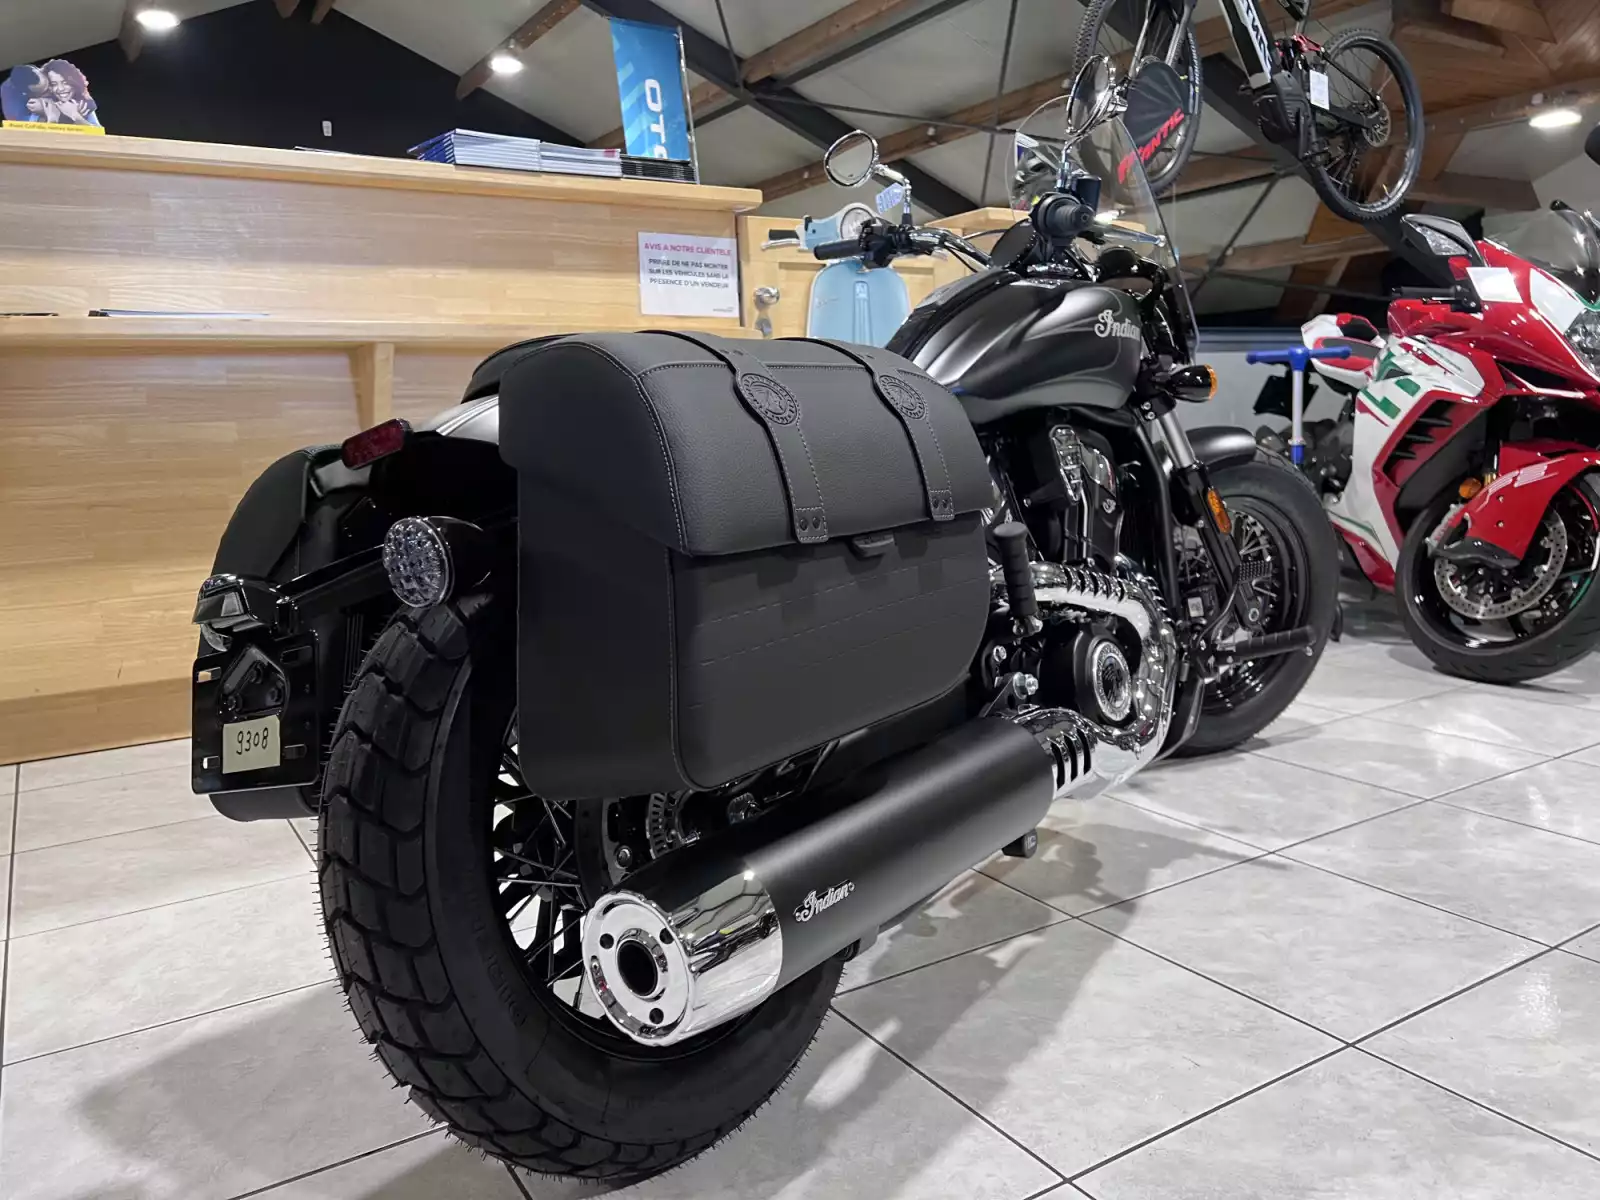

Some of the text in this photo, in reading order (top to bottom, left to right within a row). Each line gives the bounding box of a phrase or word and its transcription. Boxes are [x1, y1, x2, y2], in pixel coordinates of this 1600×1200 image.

[644, 242, 661, 250] AVIS
[670, 244, 695, 252] NOTRE
[696, 247, 732, 255] CLIENTELE
[704, 262, 728, 270] MONTER
[701, 280, 729, 288] VENDEUR
[1094, 309, 1141, 341] Indian
[236, 727, 269, 755] 9308
[796, 881, 855, 922] Indian
